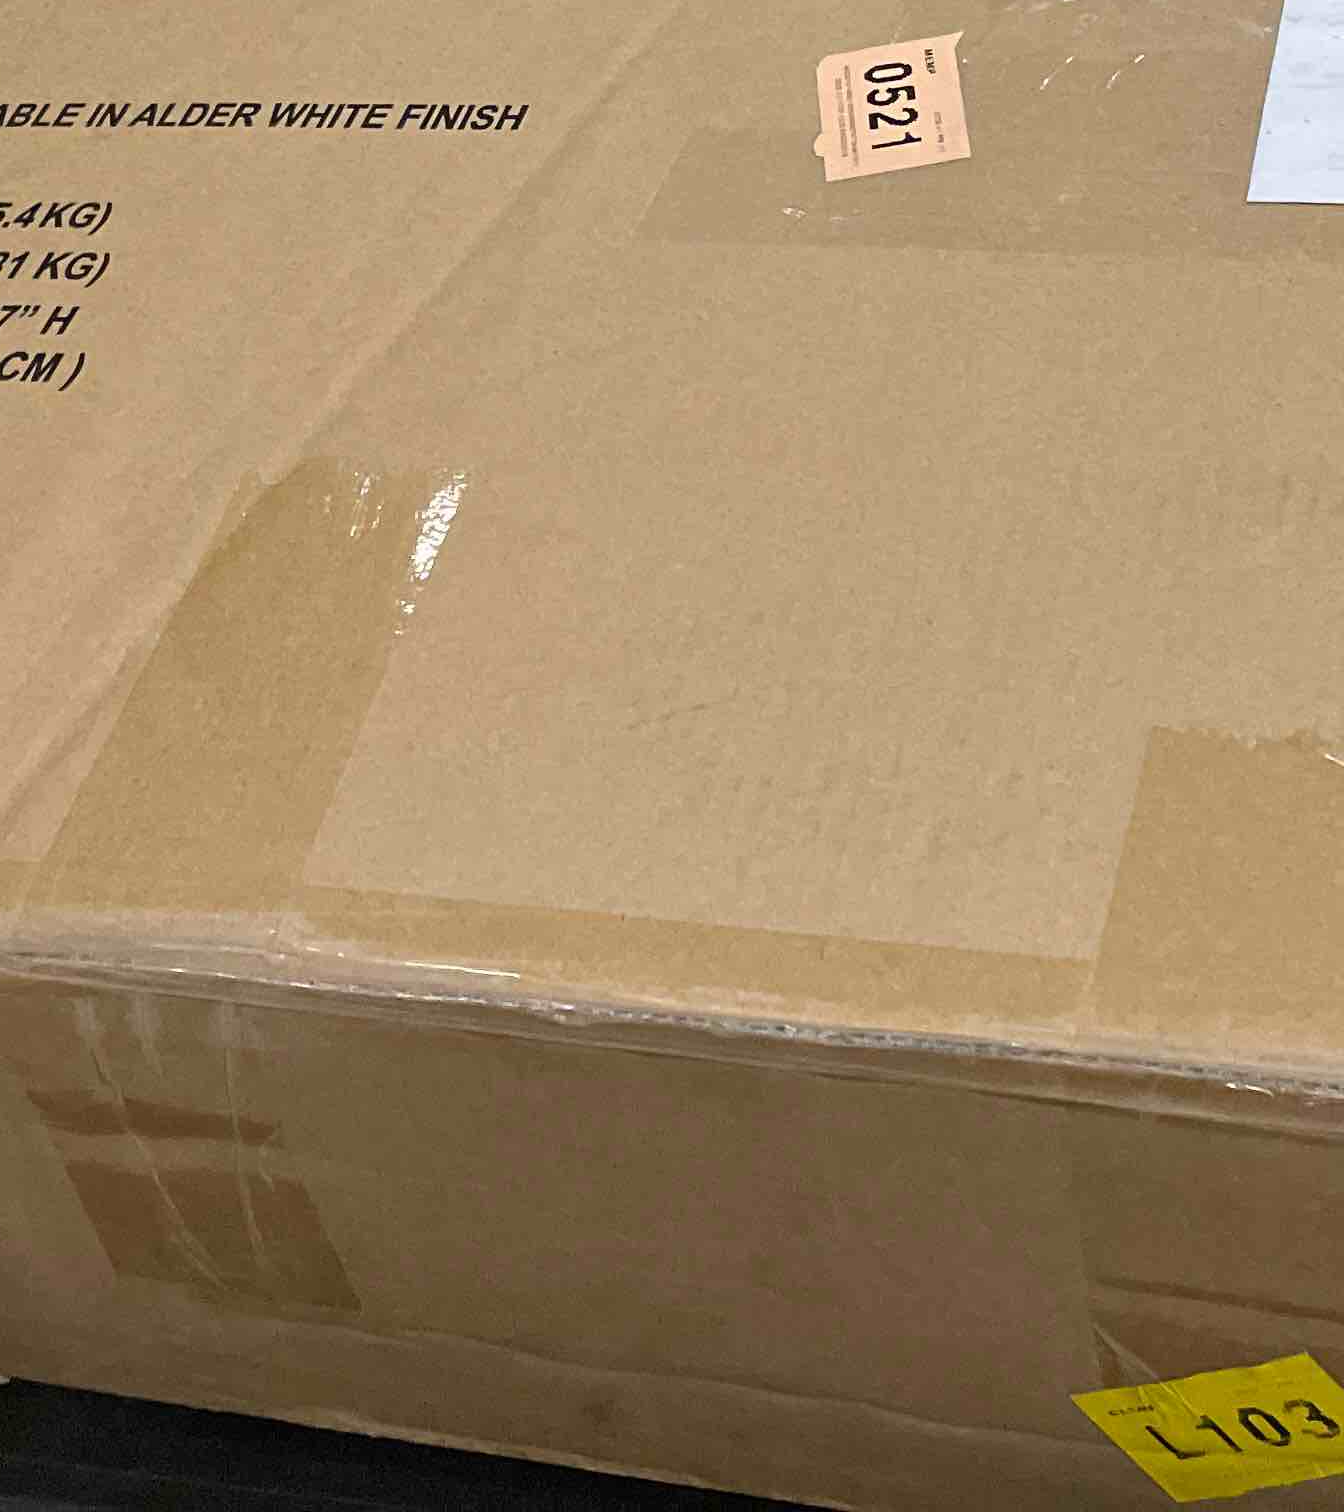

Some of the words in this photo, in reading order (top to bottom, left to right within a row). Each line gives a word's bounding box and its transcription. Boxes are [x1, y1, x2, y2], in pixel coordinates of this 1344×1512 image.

[85, 103, 132, 128] IN
[129, 102, 262, 128] ALDER
[268, 103, 394, 130] WHITE
[395, 104, 529, 131] FINISH
[864, 62, 922, 149] 0521
[32, 251, 110, 288] KG)
[40, 306, 80, 335] H
[1145, 1399, 1341, 1459] L103
